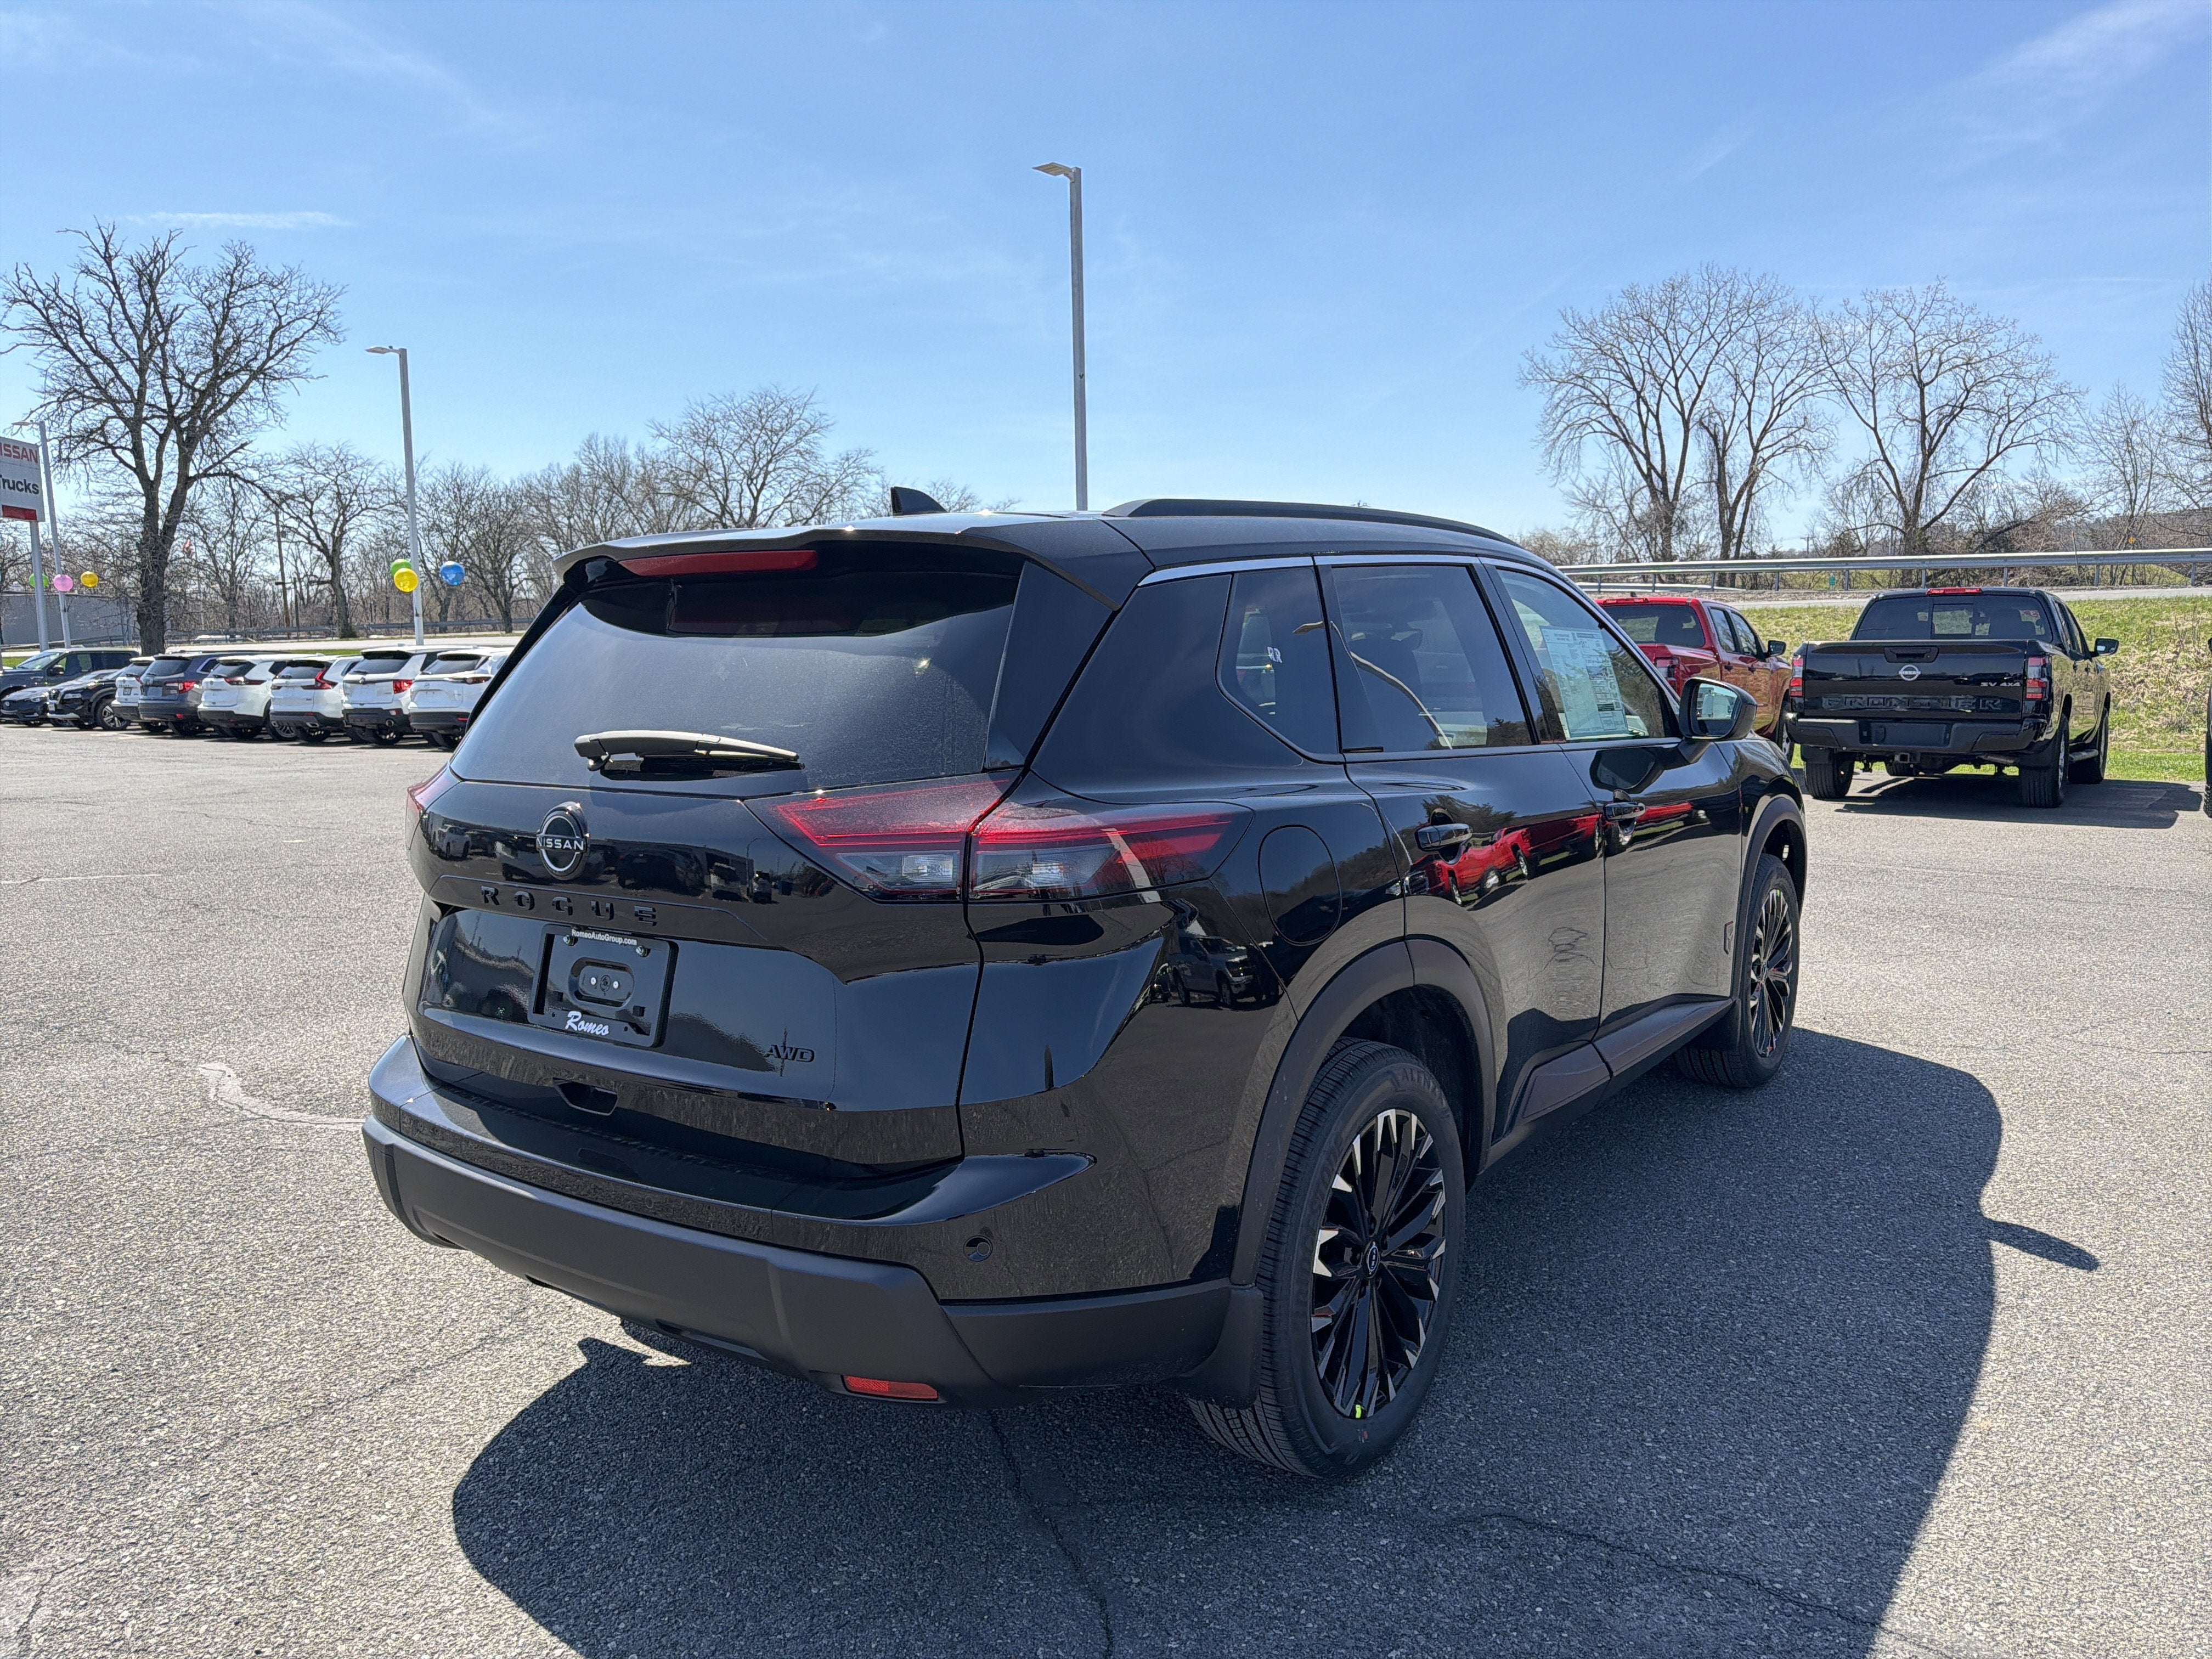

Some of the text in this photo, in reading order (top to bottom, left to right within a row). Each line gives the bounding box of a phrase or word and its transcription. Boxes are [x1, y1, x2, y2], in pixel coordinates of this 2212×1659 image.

[1822, 694, 2002, 710] FRONTIER
[537, 837, 584, 850] NISSAN
[480, 885, 657, 926] ROGUE
[572, 928, 637, 946] RomeoAutoGroup.com
[565, 1011, 610, 1036] Romeo
[763, 1044, 815, 1063] AWD
